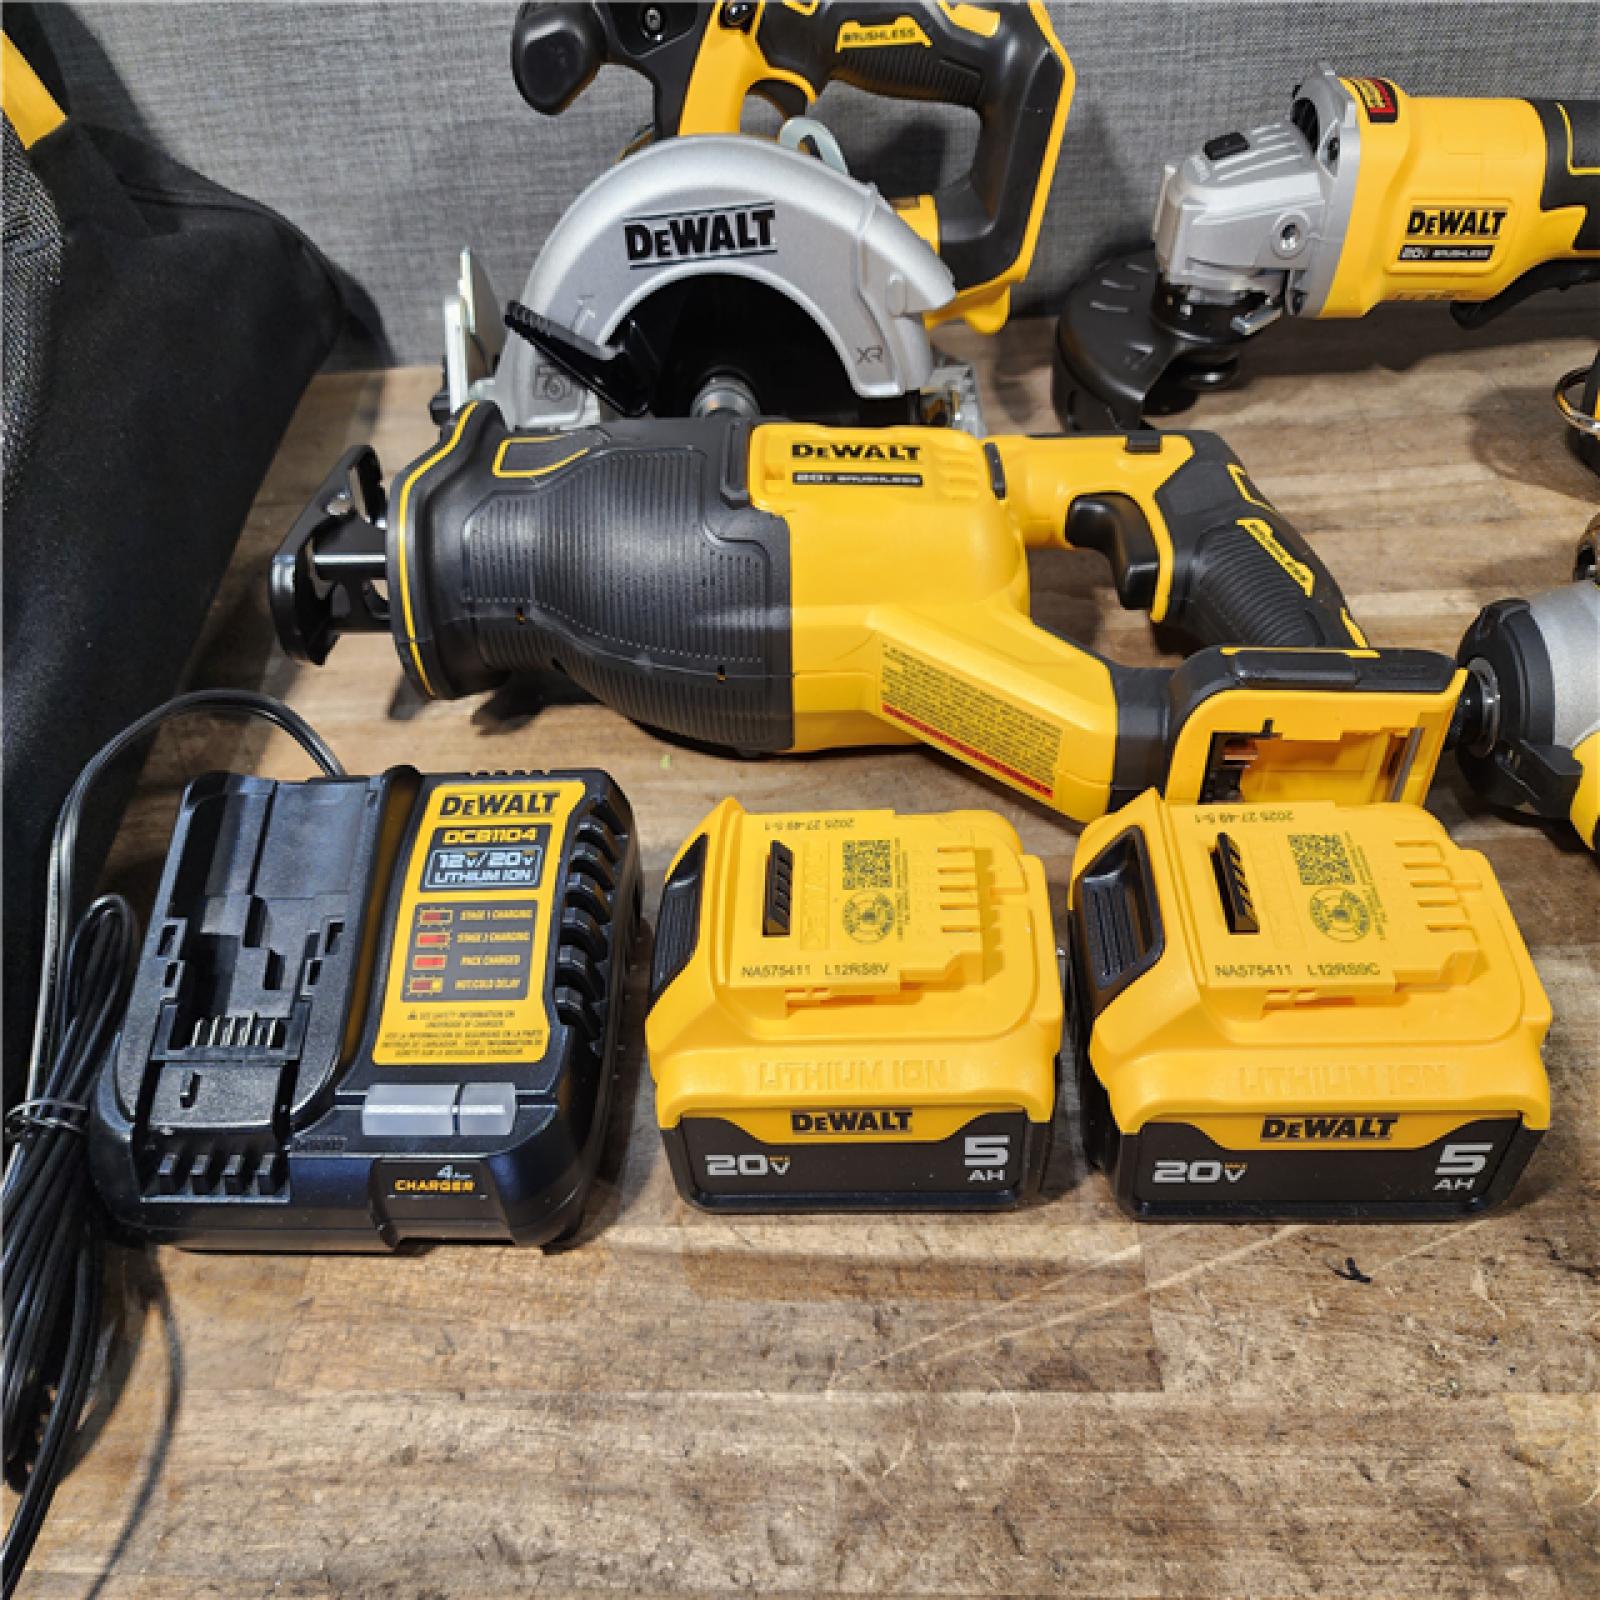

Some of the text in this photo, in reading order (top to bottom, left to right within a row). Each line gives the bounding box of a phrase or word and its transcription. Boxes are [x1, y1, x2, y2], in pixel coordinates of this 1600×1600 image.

[502, 869, 531, 881] ION
[964, 1135, 1010, 1166] 5
[1434, 1143, 1493, 1175] 5
[394, 1179, 475, 1193] CHARGER
